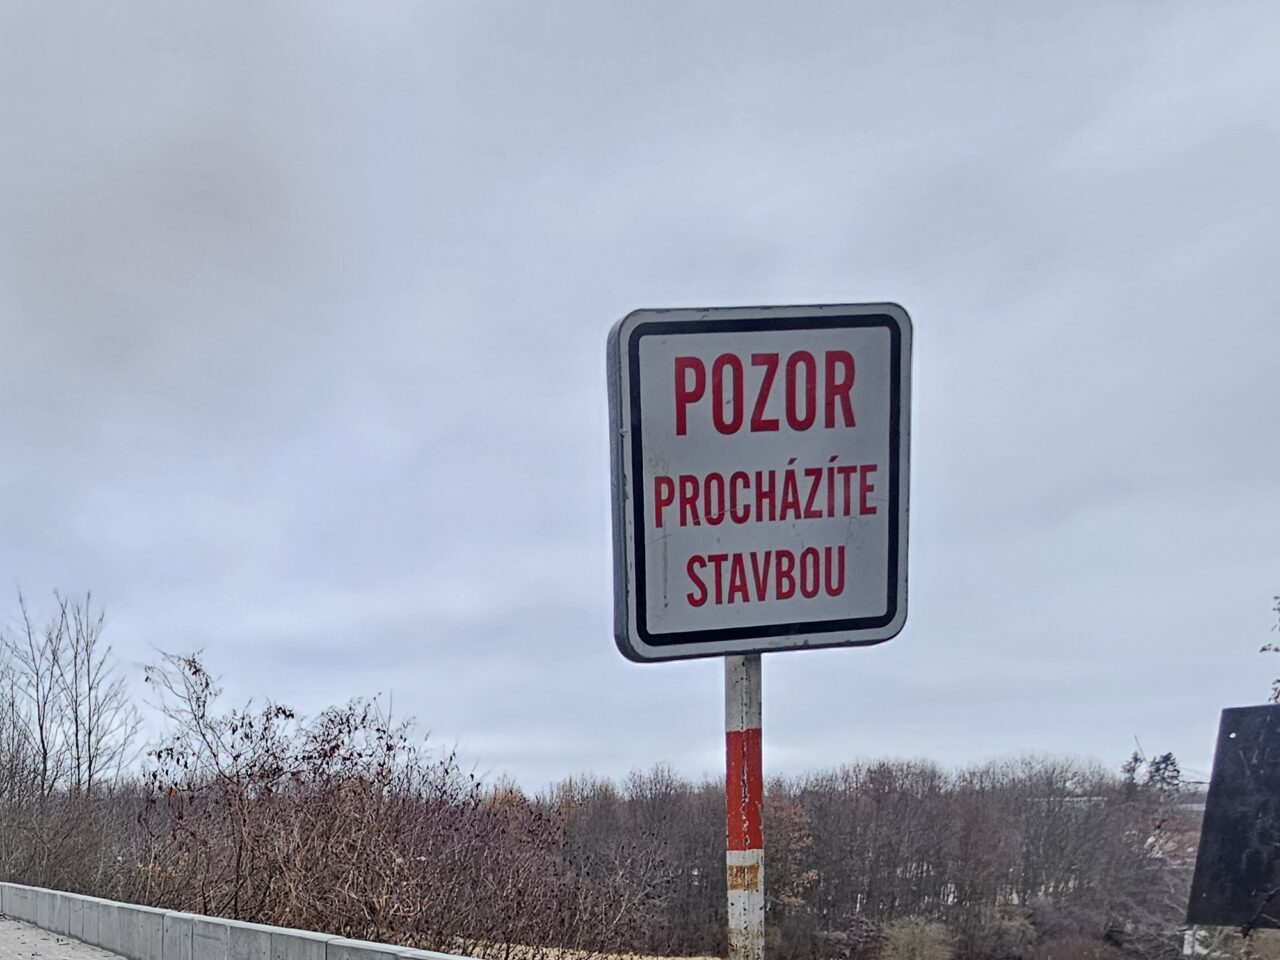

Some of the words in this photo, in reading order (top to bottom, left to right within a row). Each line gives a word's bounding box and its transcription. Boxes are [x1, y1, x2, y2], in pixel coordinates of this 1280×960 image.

[675, 350, 856, 435] POZOR
[654, 456, 877, 528] PROCHÁZÍTE
[686, 546, 846, 607] STAVBOU
